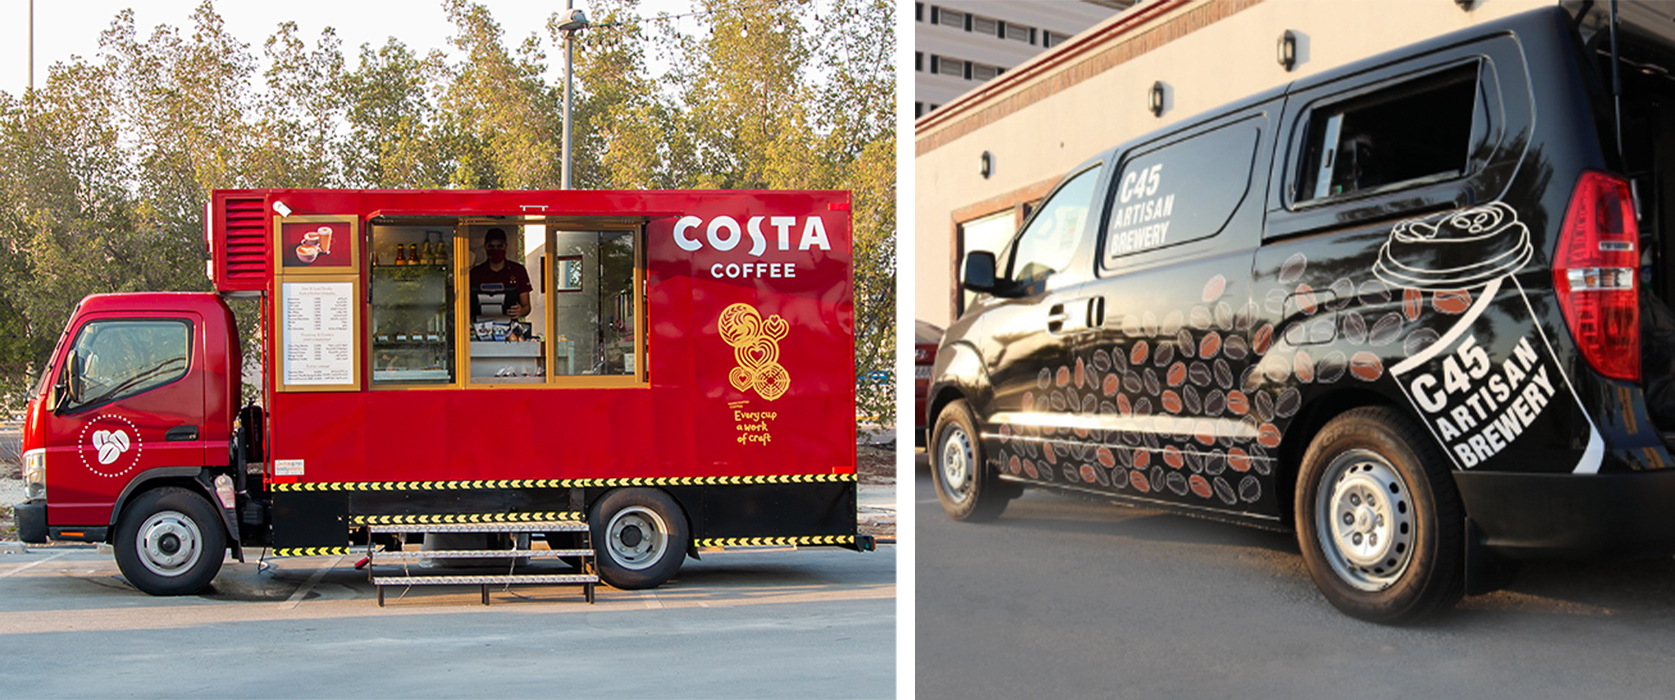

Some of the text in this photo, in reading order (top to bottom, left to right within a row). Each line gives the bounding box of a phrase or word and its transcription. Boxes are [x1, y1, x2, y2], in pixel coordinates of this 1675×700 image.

[1120, 164, 1163, 202] C45
[1114, 194, 1175, 230] ARTISAN
[673, 216, 831, 257] COSTA
[1111, 221, 1170, 253] BREWERY
[710, 263, 796, 278] COFFEE
[1411, 334, 1490, 413] C45
[1435, 336, 1538, 442] ARTISAN
[734, 410, 777, 422] Every cup
[744, 421, 768, 432] work
[1453, 364, 1556, 469] BREWERY
[737, 432, 772, 447] of craft
